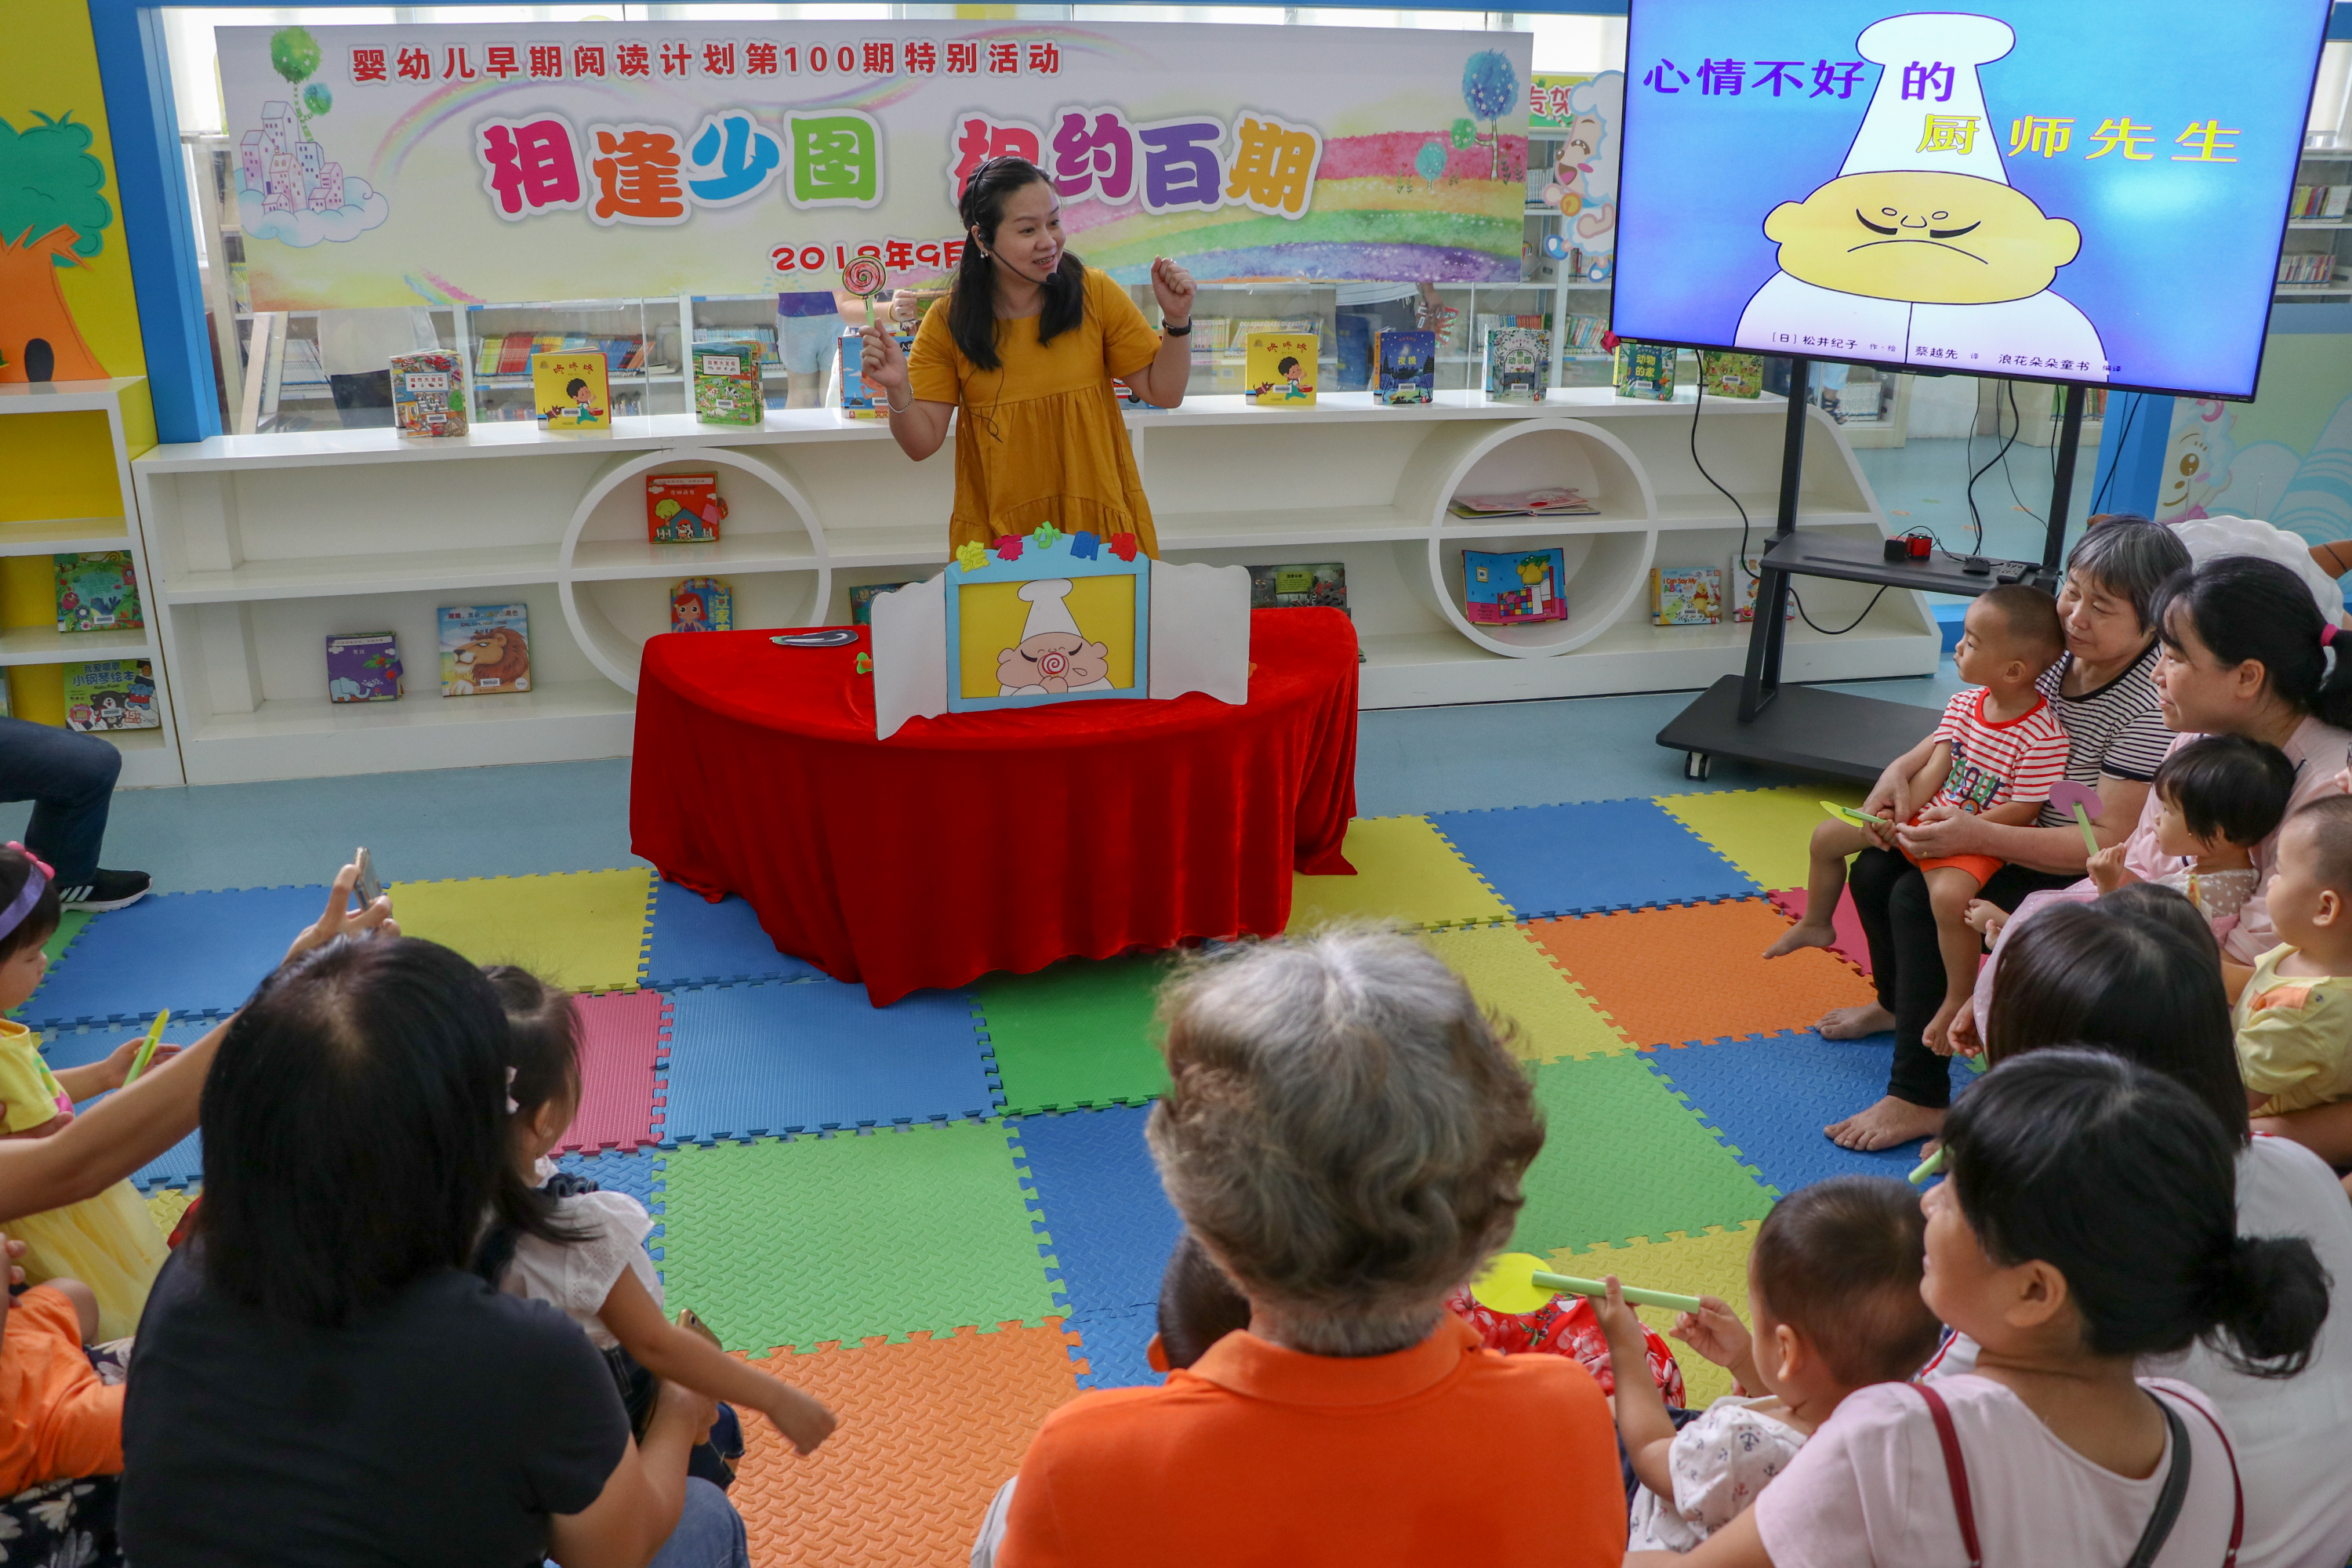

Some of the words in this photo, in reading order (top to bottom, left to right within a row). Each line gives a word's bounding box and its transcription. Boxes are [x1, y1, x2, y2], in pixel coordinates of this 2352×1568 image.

[353, 42, 1060, 82] 婴幼儿早期阅读计划第100期特别活动
[1915, 114, 2241, 163] 厨师先生
[483, 116, 877, 219] 相逢少图
[1267, 341, 1307, 353] 咚咚咚
[1397, 356, 1417, 365] 夜晚
[1636, 354, 1656, 365] 动物
[1915, 346, 1958, 360] 蔡越先
[1998, 354, 2090, 372] 浪花朵朵童书
[554, 361, 593, 374] 咚咚咚
[1635, 366, 1655, 378] 的家
[72, 670, 134, 687] 小钢琴绘本
